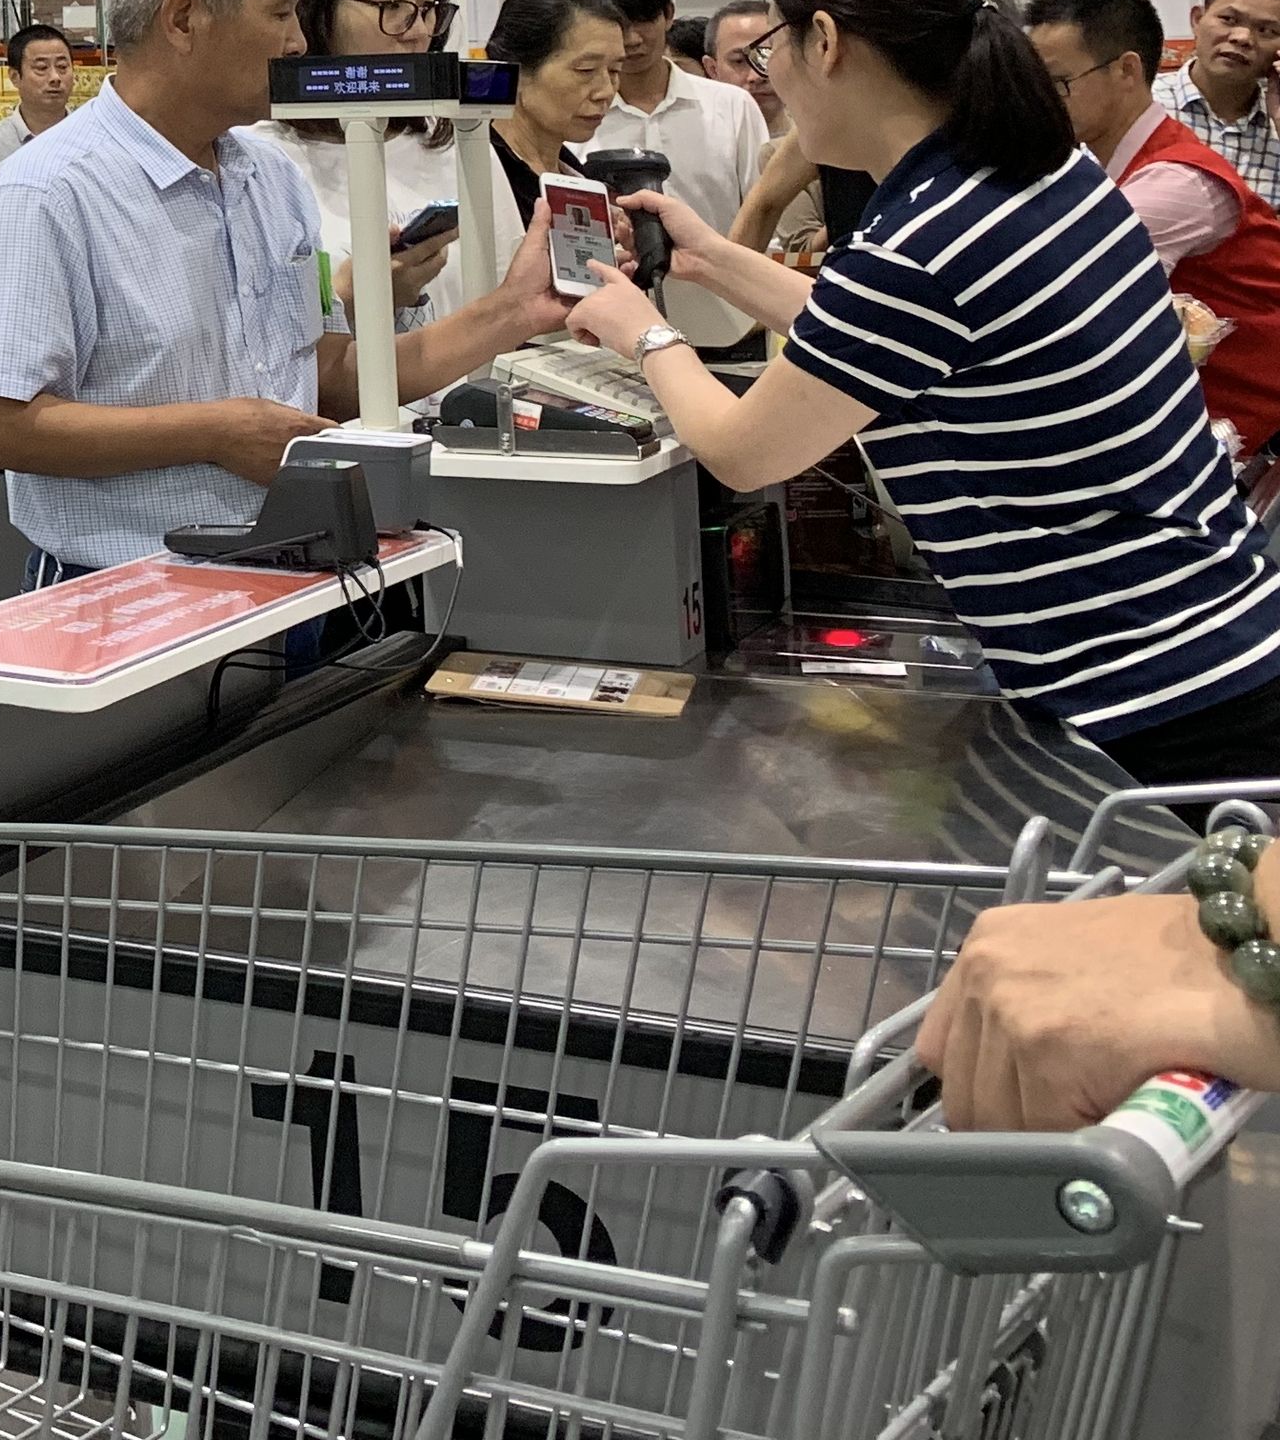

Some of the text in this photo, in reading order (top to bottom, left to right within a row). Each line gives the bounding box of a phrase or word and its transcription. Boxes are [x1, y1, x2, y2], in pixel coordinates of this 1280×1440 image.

[333, 80, 381, 95] 欢迎再来
[344, 65, 368, 79] 谢谢
[682, 581, 702, 641] 15
[250, 1049, 619, 1353] 15
